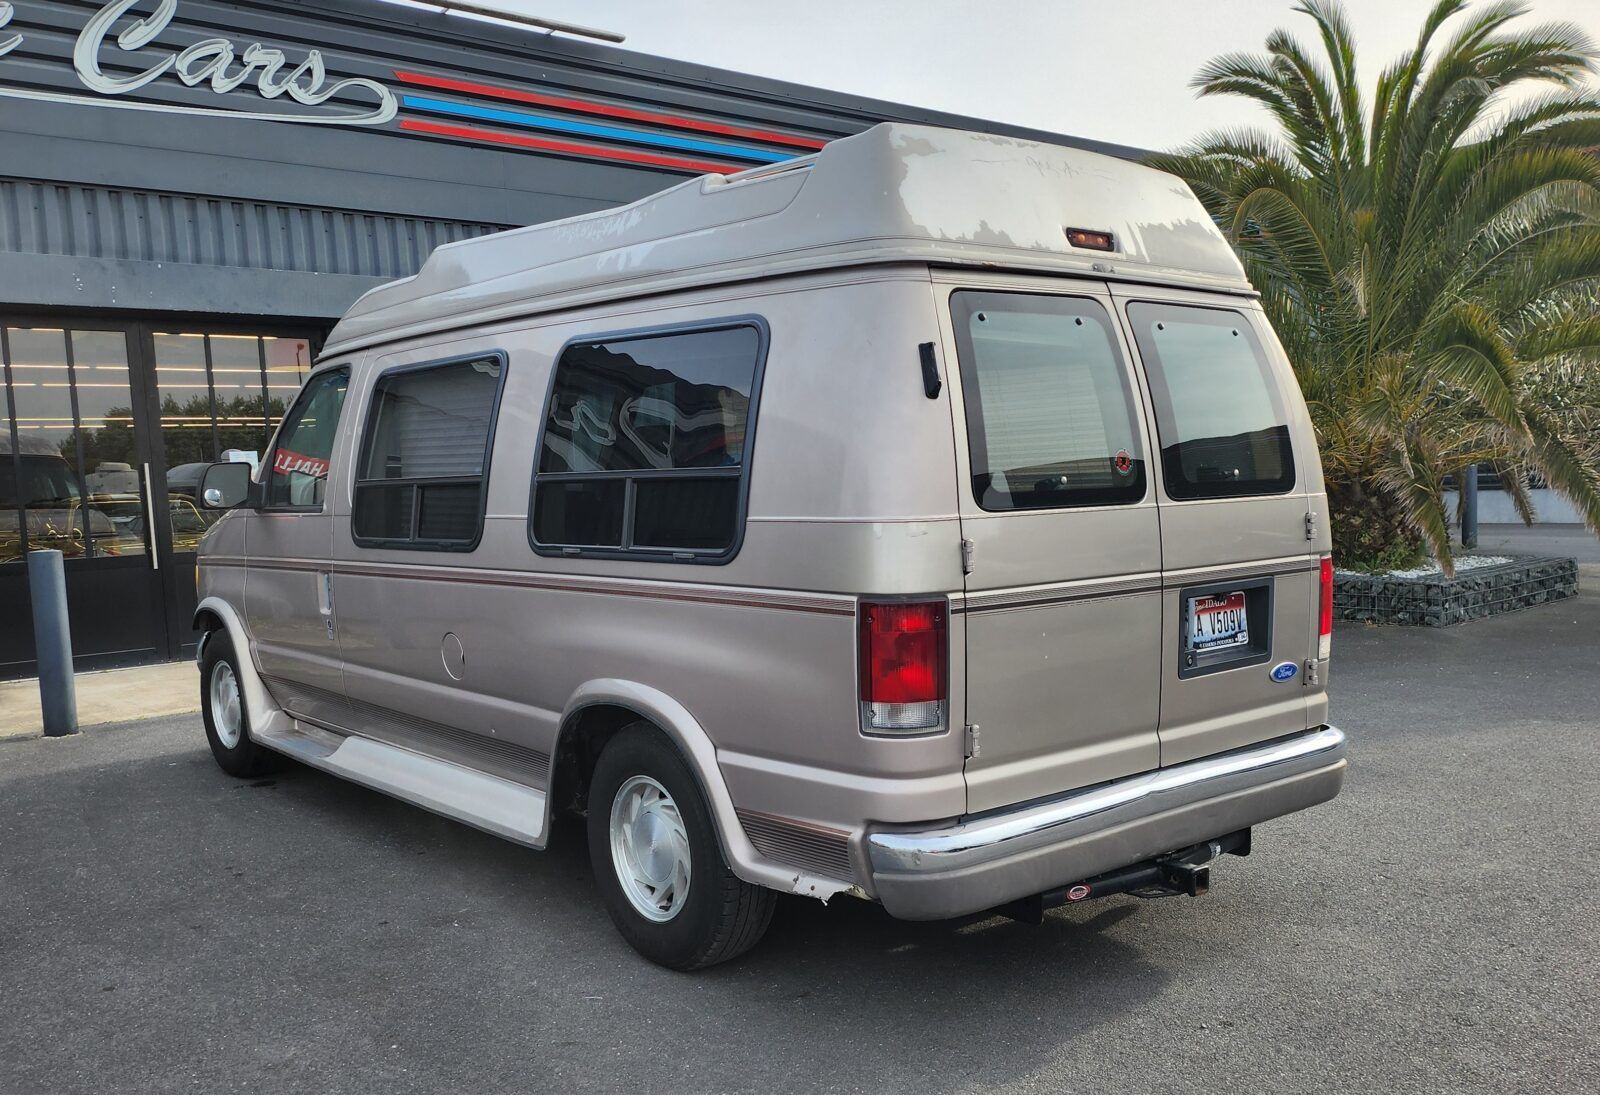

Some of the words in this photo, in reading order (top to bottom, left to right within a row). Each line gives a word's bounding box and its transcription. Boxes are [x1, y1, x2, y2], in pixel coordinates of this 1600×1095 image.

[73, 0, 390, 120] Cars
[1193, 614, 1204, 638] A
[1209, 607, 1242, 636] V509V
